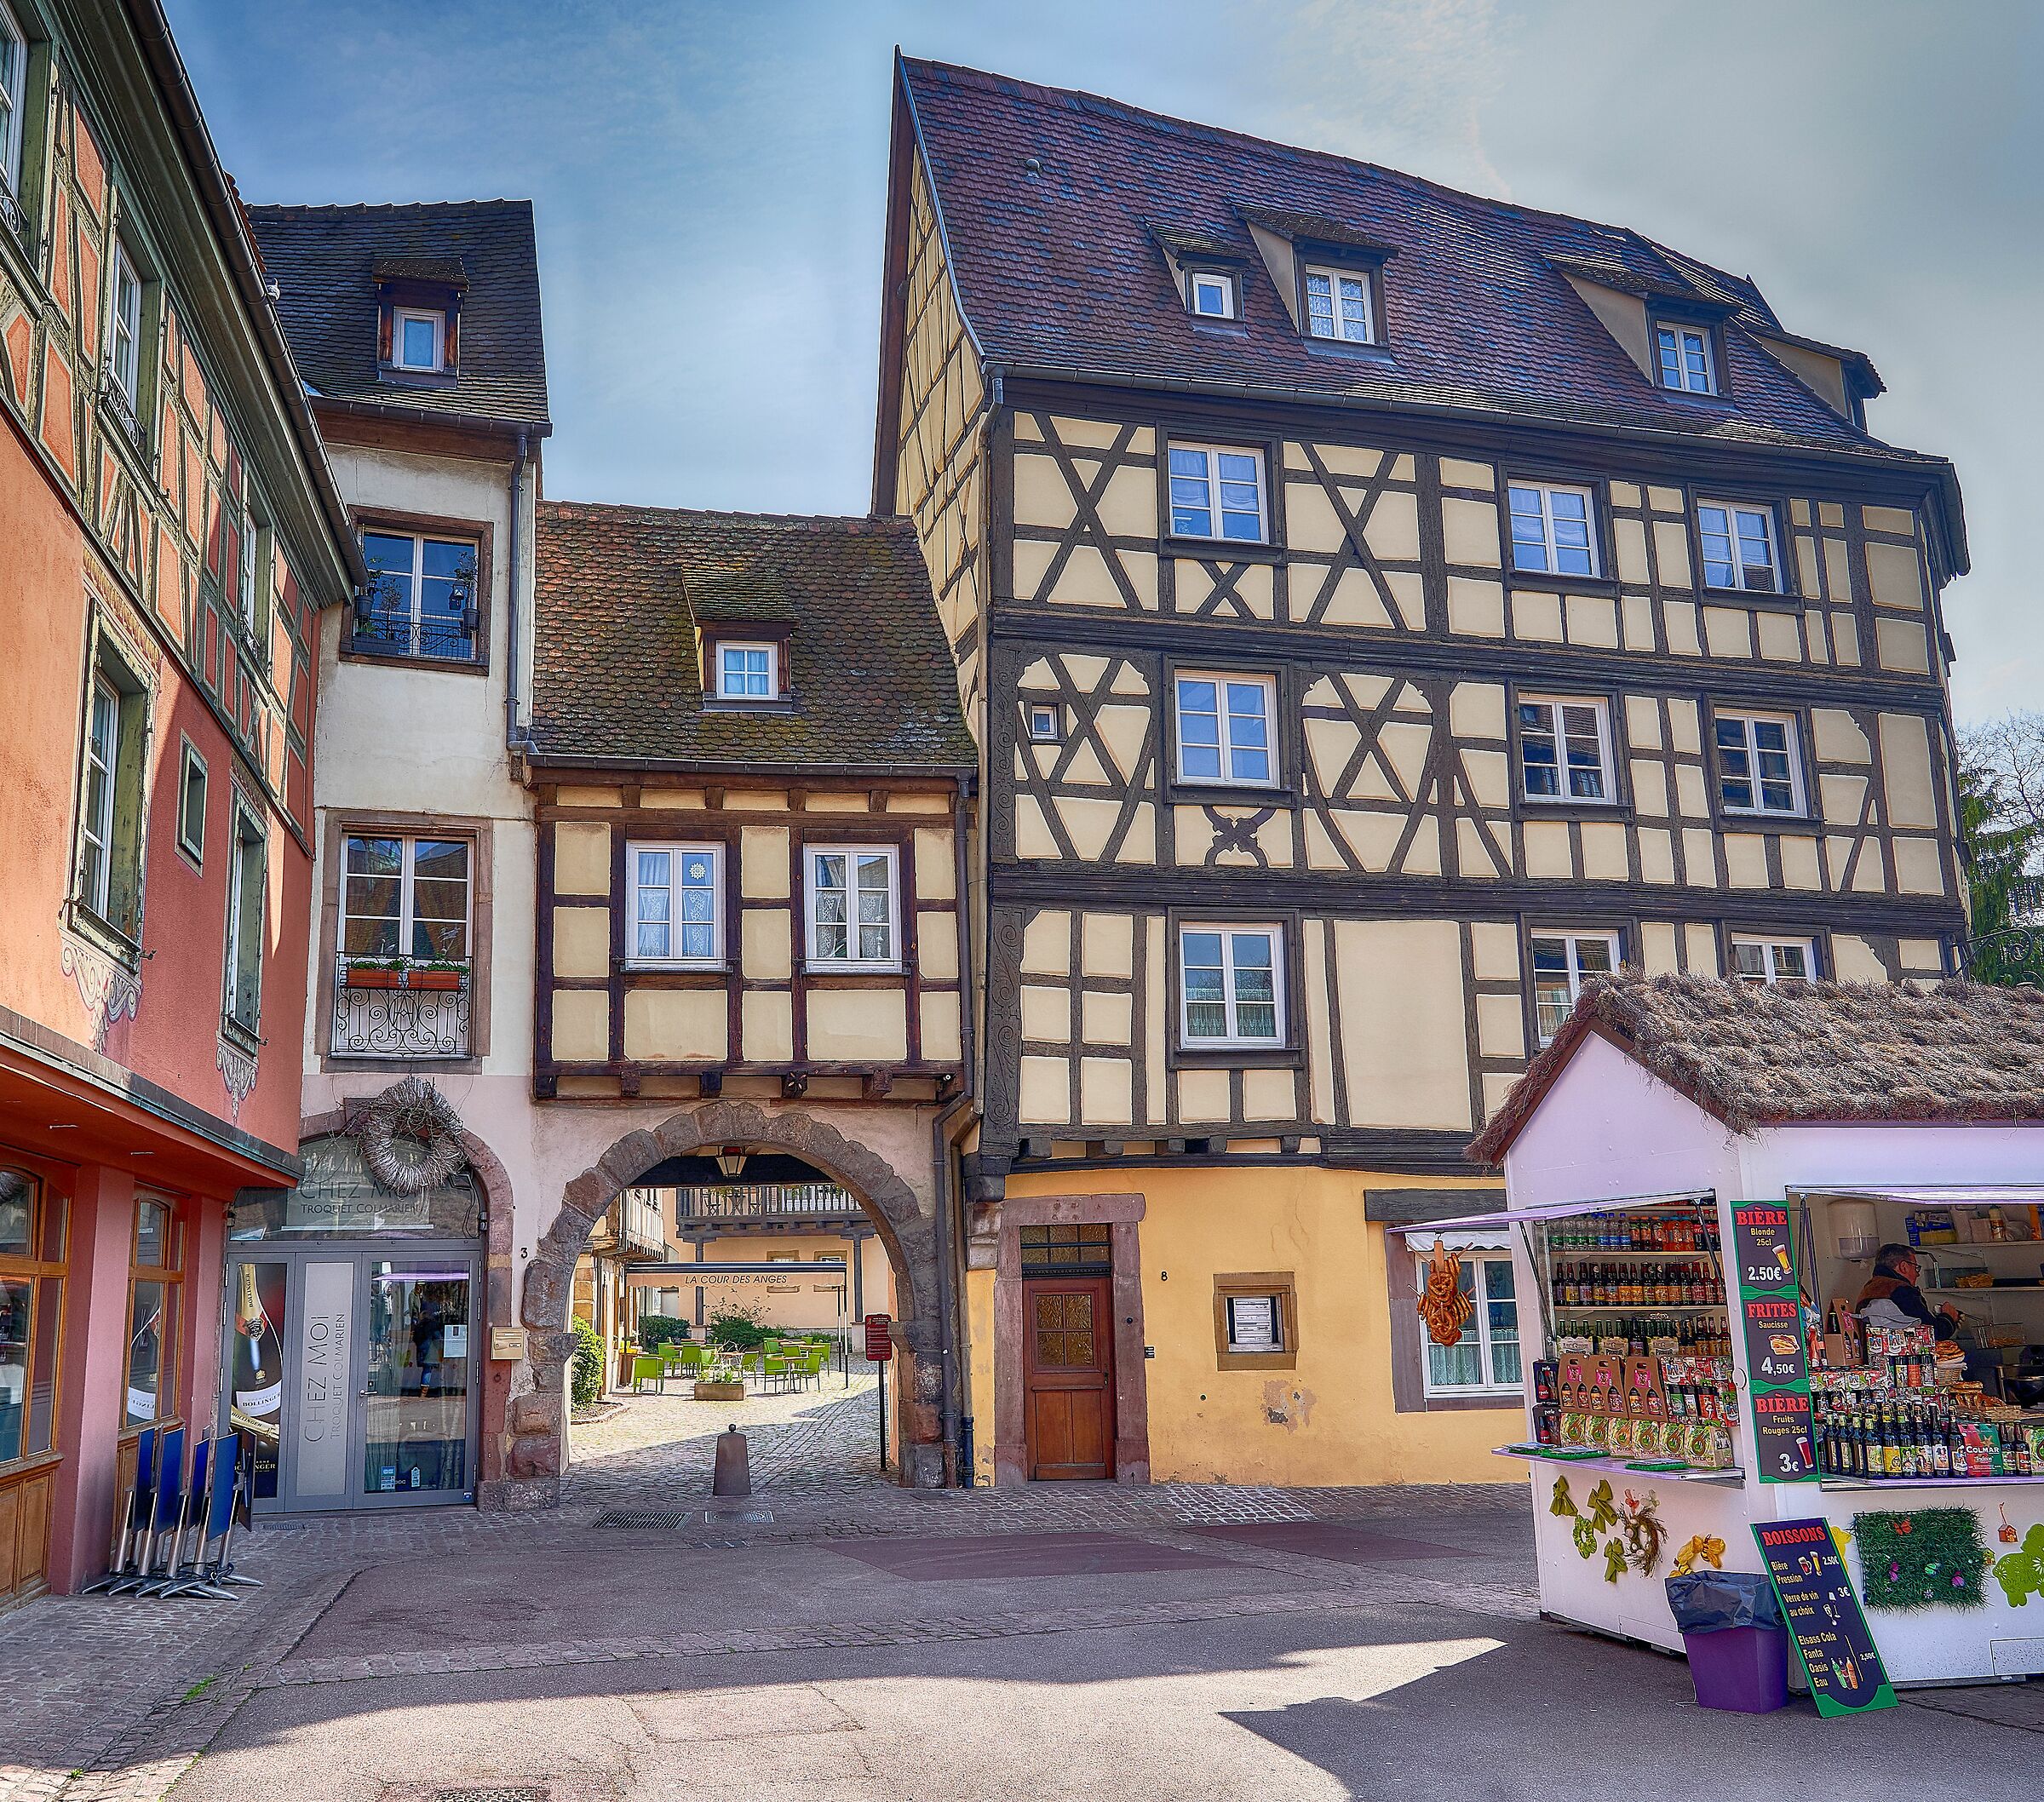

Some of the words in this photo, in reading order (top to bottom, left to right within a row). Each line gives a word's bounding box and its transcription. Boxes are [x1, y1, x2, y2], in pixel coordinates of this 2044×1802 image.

[300, 1181, 361, 1199] CHEZ
[301, 1203, 353, 1214] TROQUET
[1735, 1206, 1788, 1225] BIÈRE
[1750, 1227, 1775, 1236] Blonde
[520, 1247, 528, 1259] 3
[685, 1275, 698, 1284] LA
[700, 1275, 730, 1284] COUR
[732, 1275, 750, 1284] DES
[753, 1275, 788, 1284] ANGES
[1161, 1271, 1168, 1281] 8
[1748, 1266, 1782, 1281] 2.50€
[1747, 1302, 1797, 1317] FRITES
[1758, 1320, 1788, 1329] Saucisse
[333, 1313, 345, 1380] COLMARIEN
[1761, 1357, 1795, 1376] 4,50€
[304, 1376, 327, 1442] CHEZ
[1755, 1393, 1810, 1413] BIÈRE
[330, 1384, 344, 1439] TROQUET
[1762, 1426, 1789, 1436] Rouges
[1791, 1425, 1807, 1434] 25cl
[1966, 1445, 2000, 1454] COLMAR
[1779, 1453, 1800, 1472] 3€
[1762, 1526, 1826, 1547] BOISSONS
[1771, 1560, 1788, 1571] Bière
[1776, 1573, 1803, 1584] Pression
[1783, 1593, 1801, 1603] Verre
[1800, 1592, 1809, 1601] de
[1810, 1590, 1819, 1600] vin
[1837, 1586, 1851, 1598] 3€
[1788, 1609, 1797, 1617] au
[1797, 1604, 1815, 1615] choix
[1797, 1635, 1821, 1645] Elsass
[1820, 1631, 1837, 1642] Cola
[1802, 1648, 1824, 1659] Fanta
[1808, 1661, 1829, 1673] Oasis
[1813, 1677, 1829, 1687] Eau
